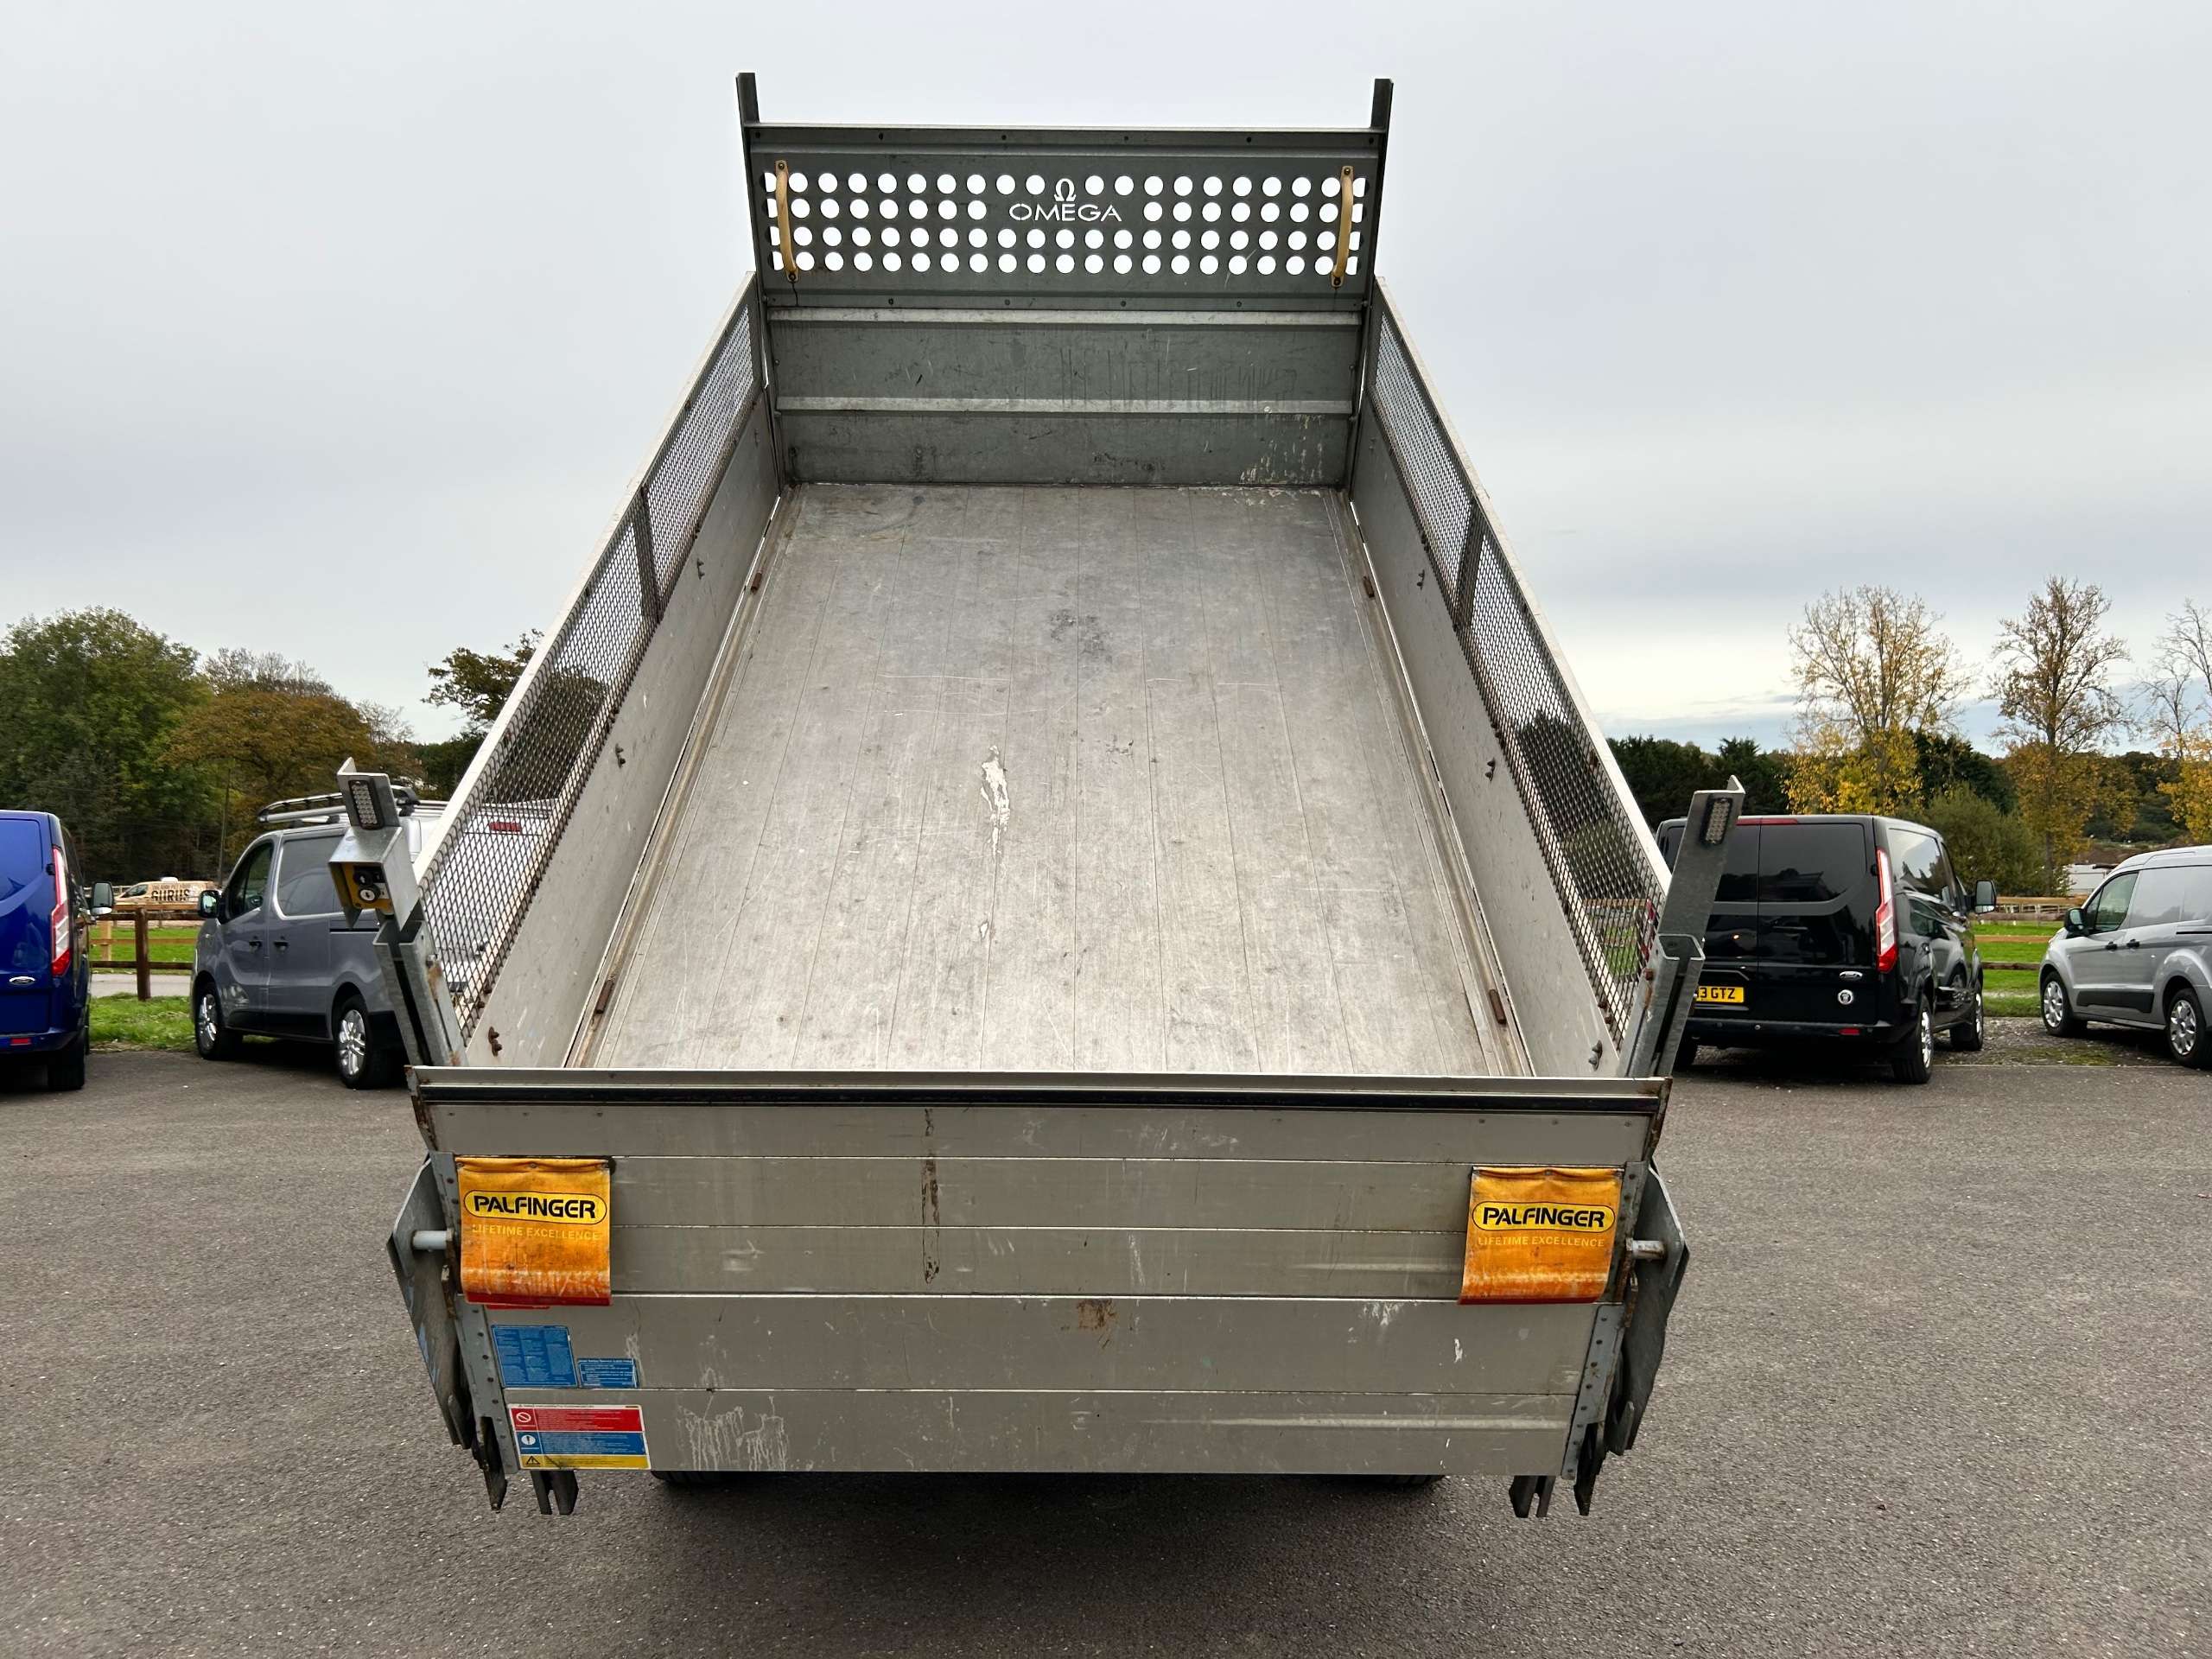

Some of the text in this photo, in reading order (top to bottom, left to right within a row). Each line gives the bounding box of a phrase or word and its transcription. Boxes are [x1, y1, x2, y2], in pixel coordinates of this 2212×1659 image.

[1009, 203, 1122, 222] OMEGA
[1711, 988, 1736, 1000] GTZ
[474, 1195, 595, 1219] PALFINGER
[1483, 1207, 1605, 1228] PALFINGER
[472, 1224, 601, 1241] LIFETIME EXCELLENCE
[1478, 1236, 1605, 1247] LIFETIME EXCELLENCE
